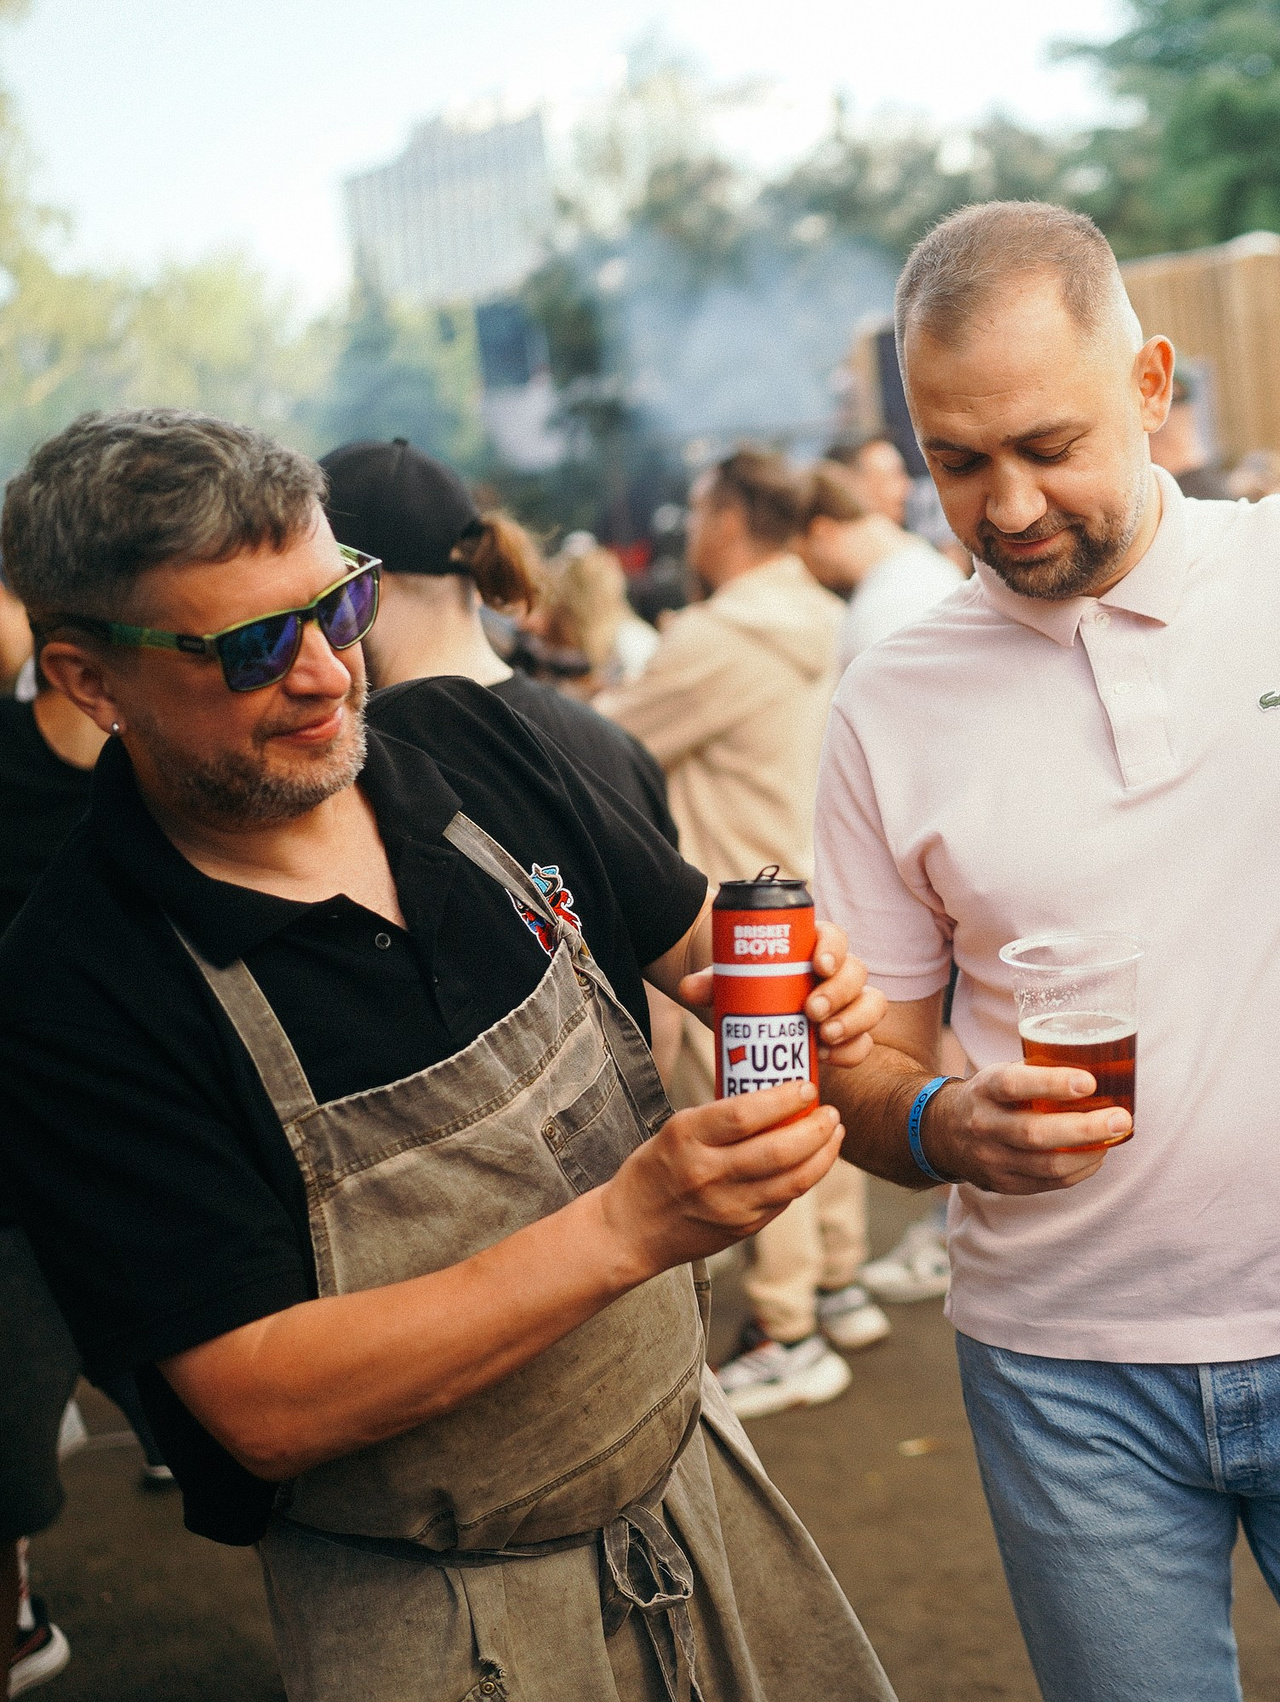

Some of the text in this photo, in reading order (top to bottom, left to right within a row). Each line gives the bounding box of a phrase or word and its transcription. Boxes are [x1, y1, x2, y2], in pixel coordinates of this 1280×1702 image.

[734, 938, 790, 956] BOYS
[726, 1021, 804, 1038] RED FLAGS
